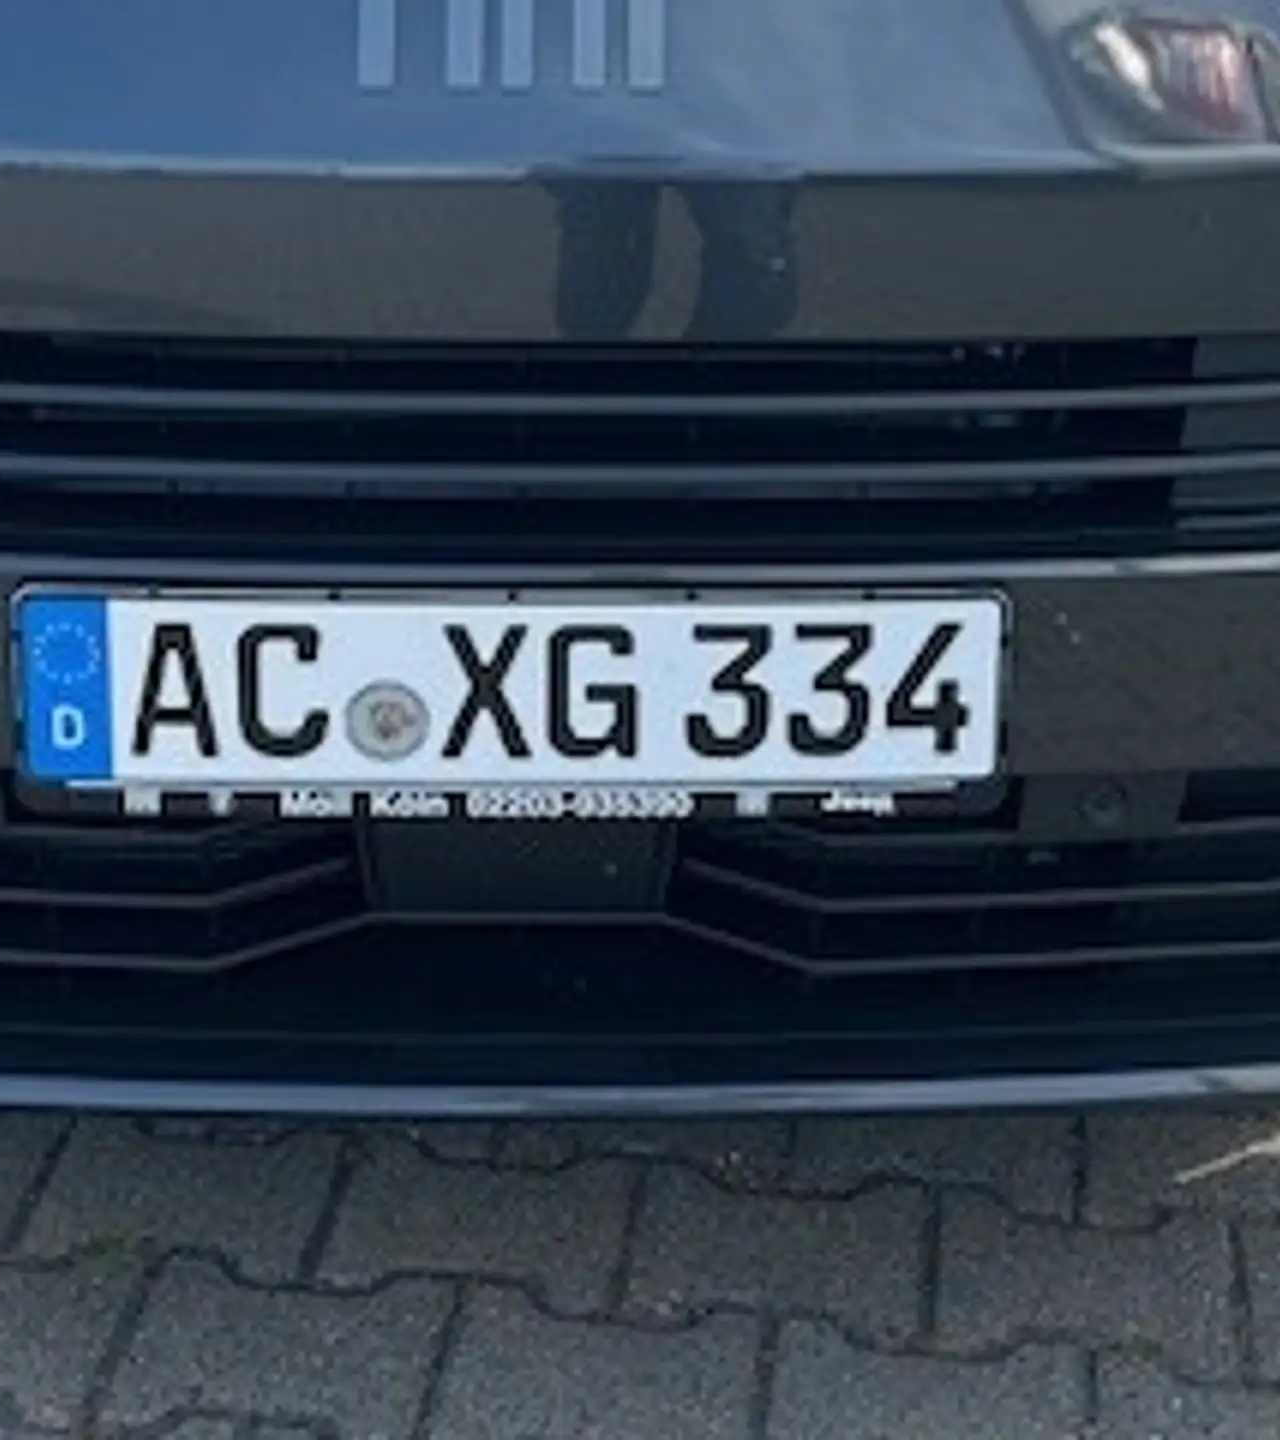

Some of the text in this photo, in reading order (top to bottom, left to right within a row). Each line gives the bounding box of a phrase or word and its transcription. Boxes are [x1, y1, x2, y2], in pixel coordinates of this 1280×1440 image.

[51, 622, 970, 759] D AC XG 334
